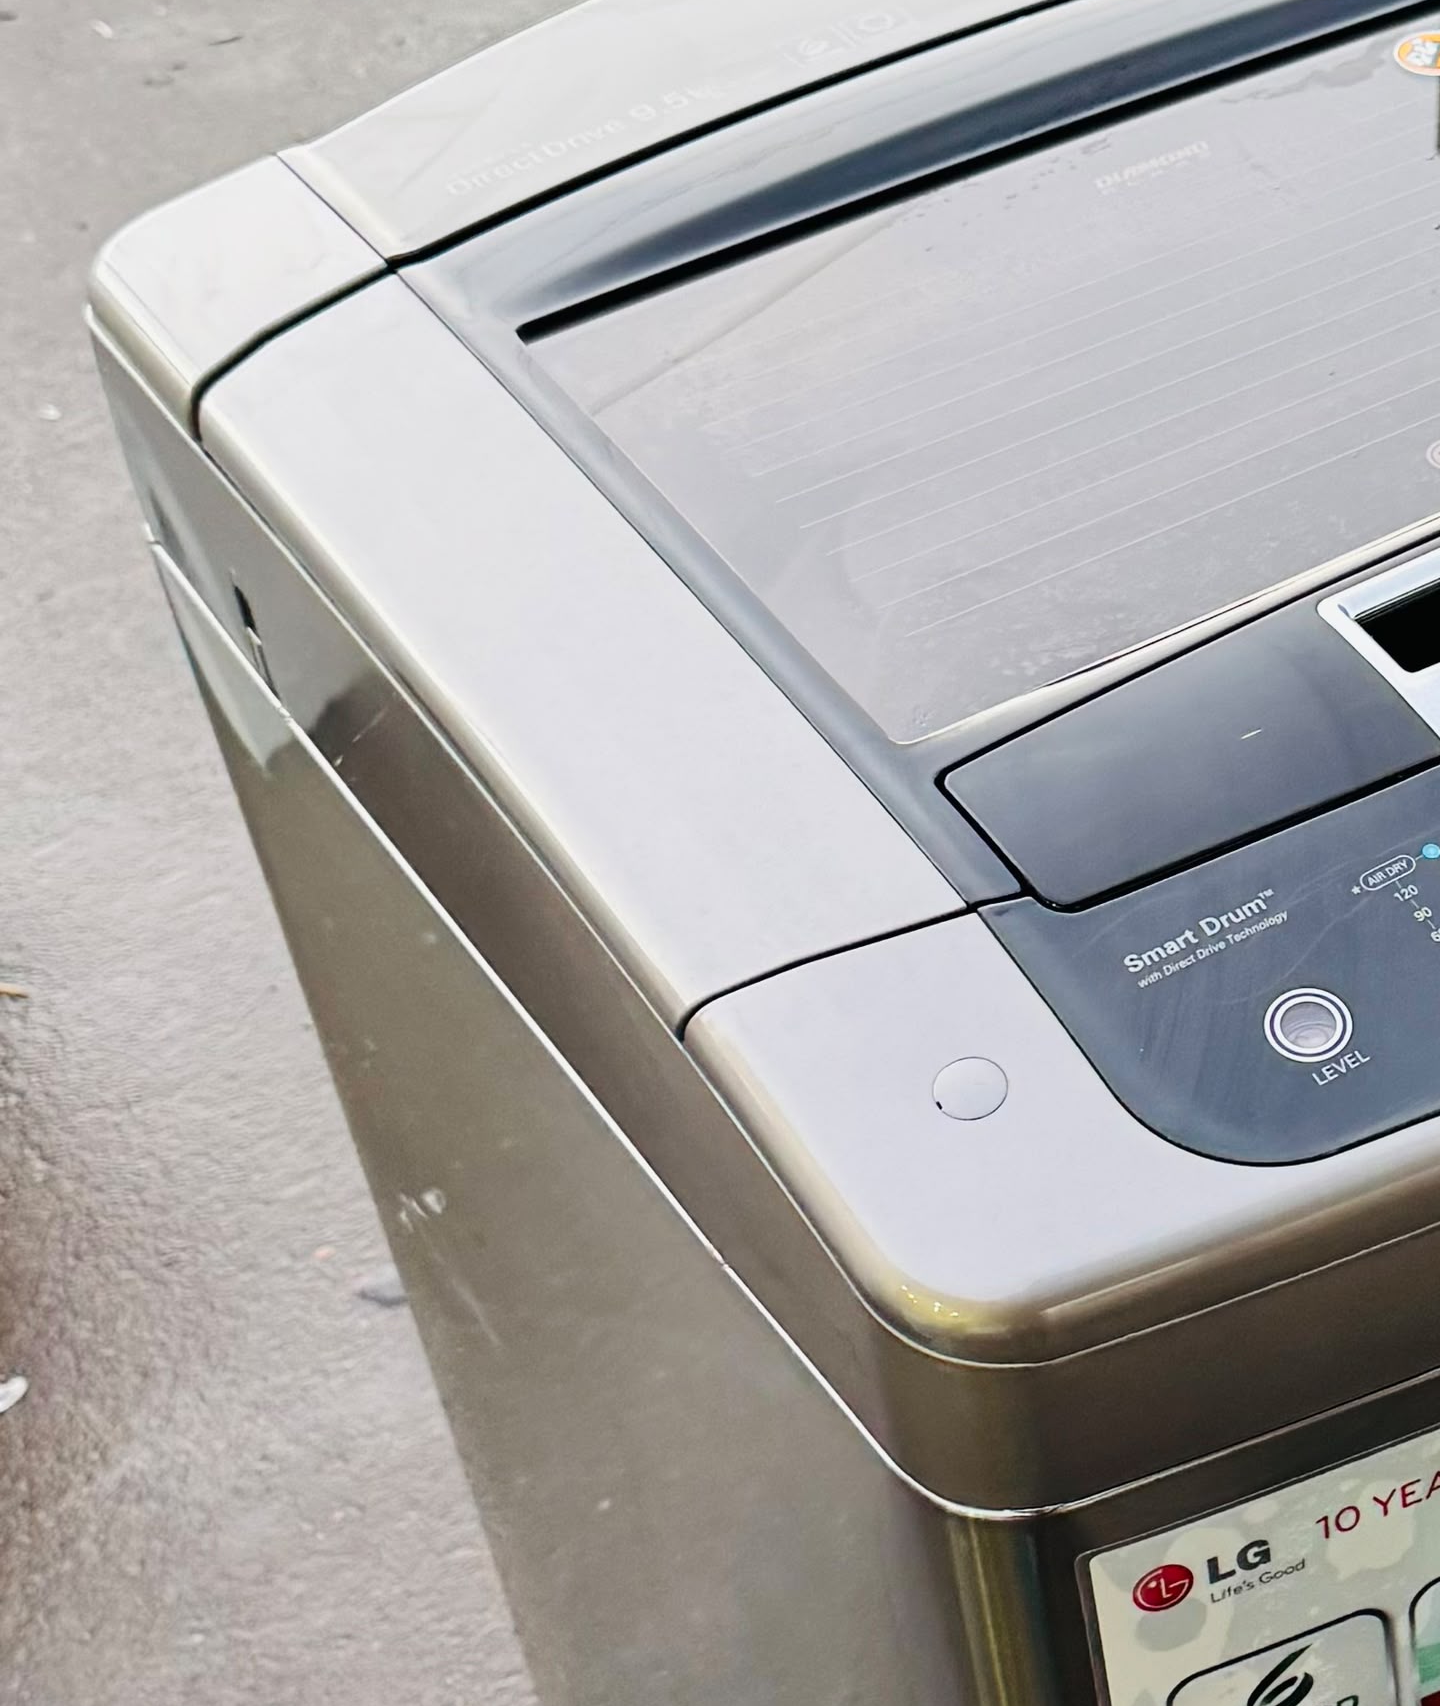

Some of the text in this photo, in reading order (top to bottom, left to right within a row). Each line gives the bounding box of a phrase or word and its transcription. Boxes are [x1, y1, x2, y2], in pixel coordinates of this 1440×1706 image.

[1367, 859, 1409, 887] AIR DRY
[1393, 884, 1418, 902] 120
[1413, 906, 1432, 922] 90
[1124, 928, 1199, 973] Smart
[1138, 910, 1288, 988] with Direct Drive Technology
[1311, 1049, 1371, 1087] LEVEL
[1315, 1504, 1361, 1540] 10
[1206, 1539, 1271, 1584] LG
[1210, 1558, 1307, 1604] Life's Good
